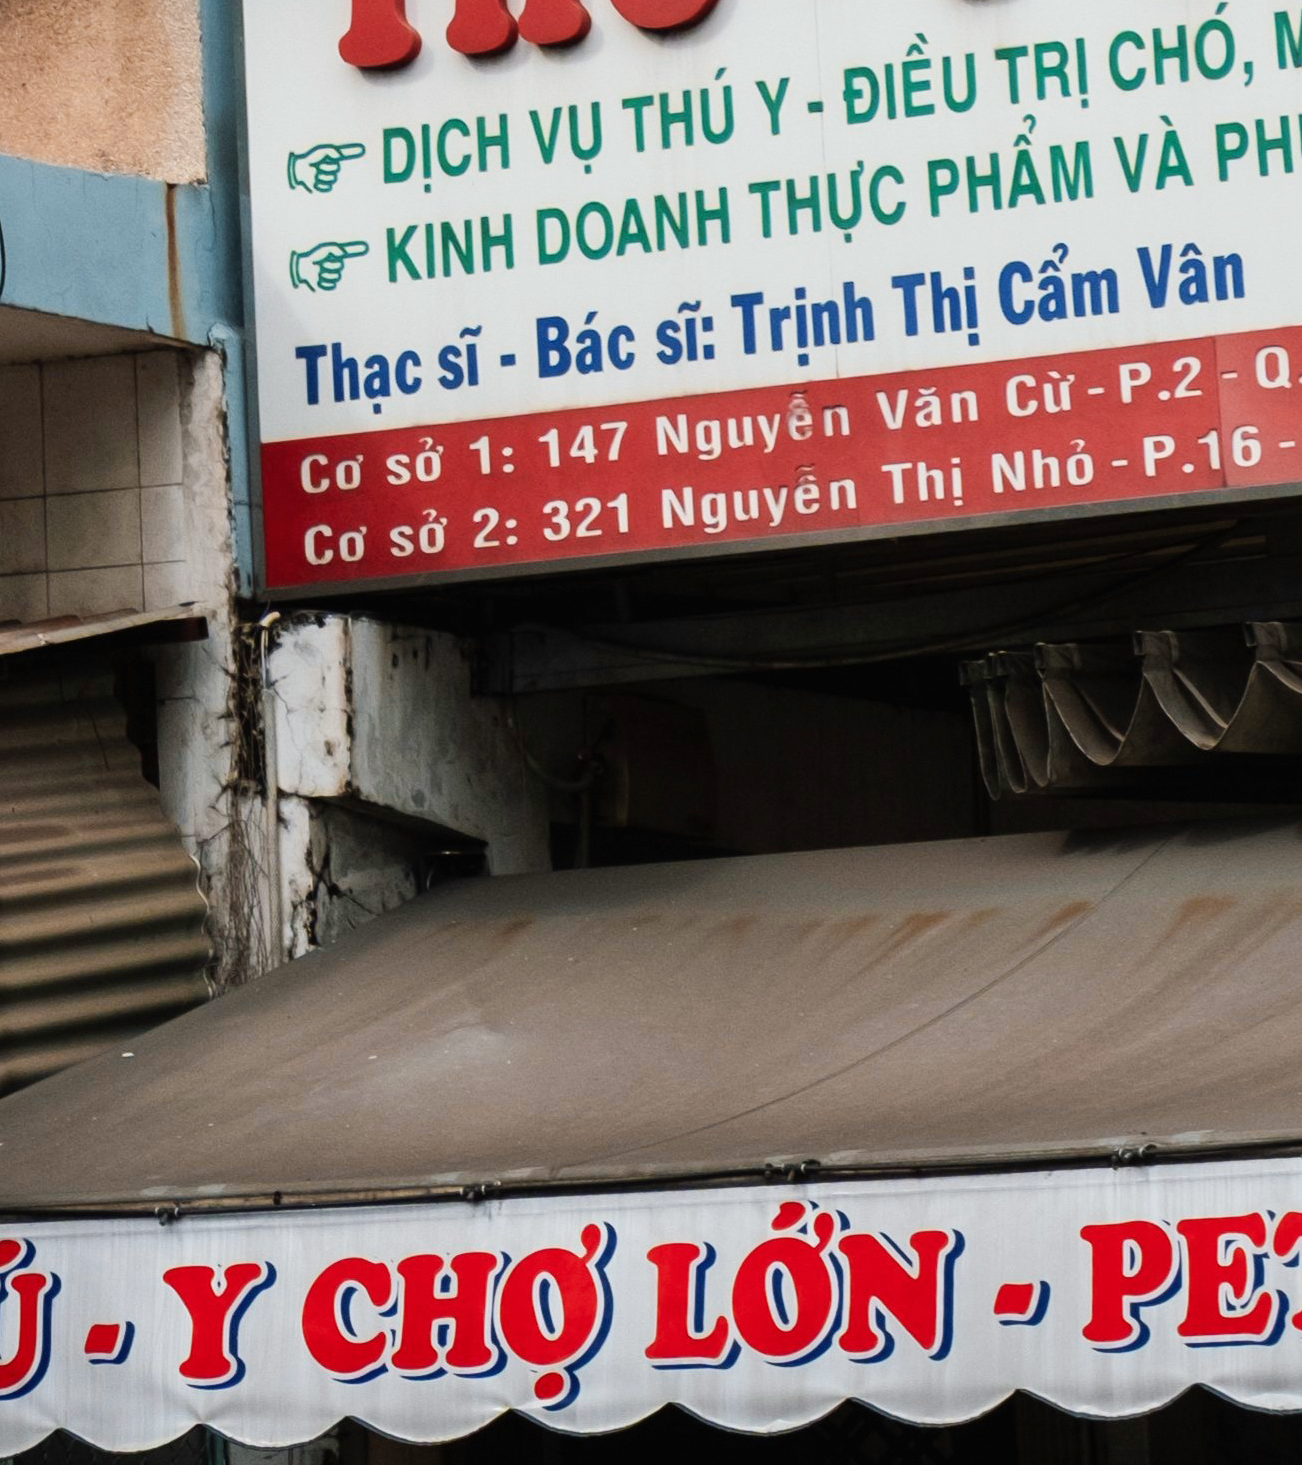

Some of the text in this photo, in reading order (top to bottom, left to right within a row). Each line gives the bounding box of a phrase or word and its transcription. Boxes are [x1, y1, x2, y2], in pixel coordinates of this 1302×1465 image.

[381, 112, 512, 194] DỊCH
[527, 101, 604, 175] VỤ
[621, 66, 736, 154] THÚ
[755, 76, 792, 136] Y
[842, 31, 979, 126] ĐIỀU
[993, 36, 1091, 109] TRỊ
[1107, 0, 1256, 93] CHÓ,
[385, 111, 1302, 284] KINH DOANH THỰC PHẨM VÀ PH
[295, 340, 424, 416] Thạc
[437, 323, 483, 390] sĩ
[534, 310, 637, 380] Bác
[655, 298, 717, 366] sĩ:
[731, 286, 876, 368] Trịnh
[891, 265, 980, 347] Thị
[997, 241, 1121, 326] Cẩm
[1136, 240, 1247, 310] Vân
[299, 451, 365, 495] Cơ
[384, 436, 446, 485] sở
[468, 434, 517, 476] 1:
[538, 419, 630, 469] 147
[654, 389, 852, 463] Nguyễn
[874, 385, 980, 432] Văn
[1004, 369, 1078, 418] Cừ
[1117, 354, 1204, 404] P.2
[1255, 344, 1302, 390] Q
[302, 522, 369, 567] Cơ
[388, 507, 449, 559] sở
[472, 506, 521, 551] 2:
[541, 492, 631, 543] 321
[660, 462, 858, 536] Nguyễn
[880, 457, 964, 508] Thị
[990, 438, 1095, 495] Nhỏ
[1142, 425, 1263, 478] P.16
[163, 1260, 278, 1392] Y
[301, 1221, 616, 1412] CHỢ
[644, 1199, 966, 1369] LỚN
